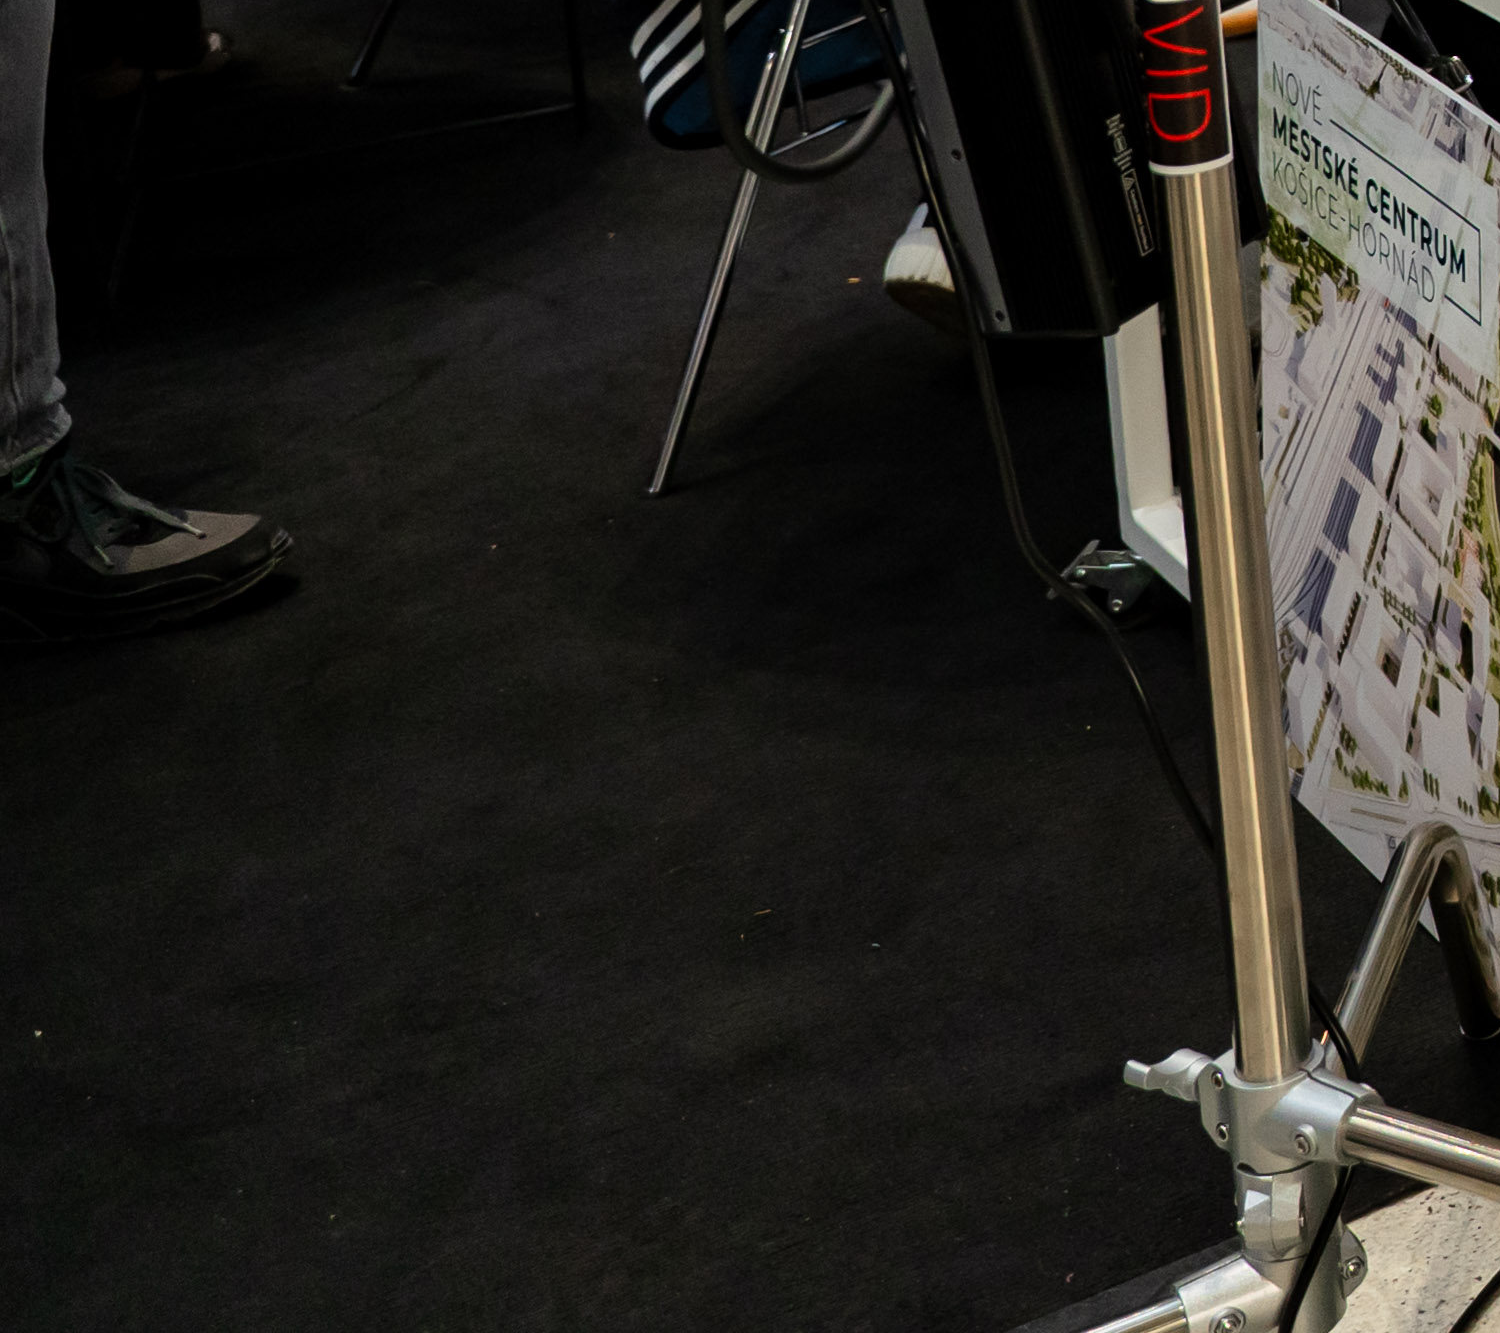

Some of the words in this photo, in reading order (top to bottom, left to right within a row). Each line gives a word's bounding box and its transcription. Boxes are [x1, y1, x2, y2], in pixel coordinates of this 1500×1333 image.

[1272, 61, 1323, 126] NOVÉ
[1272, 150, 1436, 303] KOŠICE-HORNÁD
[1273, 107, 1359, 200] MESTSKÉ
[1366, 178, 1466, 283] CENTRUM
